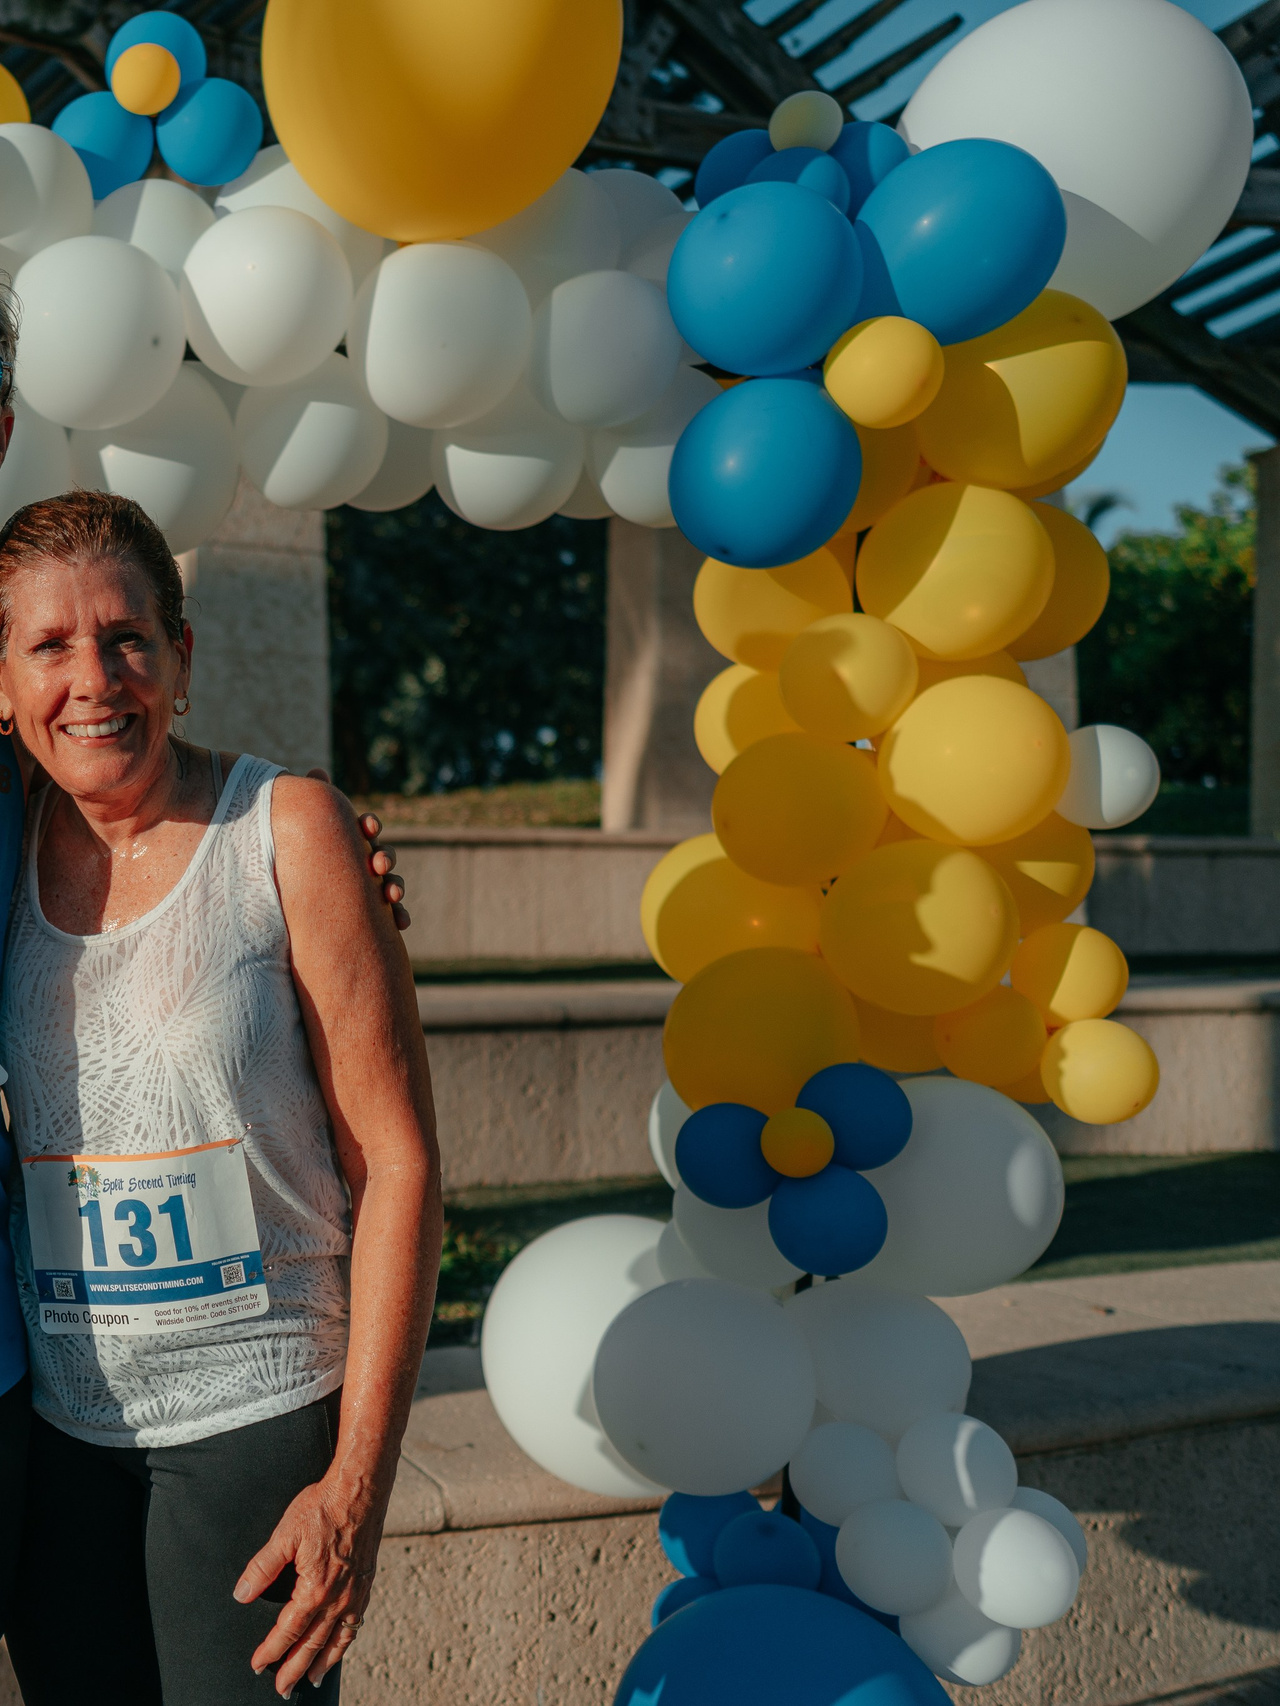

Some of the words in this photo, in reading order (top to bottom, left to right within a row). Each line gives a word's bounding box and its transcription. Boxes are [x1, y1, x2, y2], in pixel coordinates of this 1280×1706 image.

[102, 1178, 124, 1195] Split
[128, 1175, 164, 1192] Second
[166, 1172, 196, 1188] Timing
[78, 1194, 193, 1267] 131
[90, 1276, 204, 1292] WWW.SPLITSECONDTIMING.COM
[154, 1308, 171, 1317] Good
[173, 1307, 182, 1315] for
[184, 1305, 199, 1313] 10%
[200, 1302, 210, 1311] off
[211, 1299, 233, 1309] events
[234, 1294, 249, 1303] shot
[250, 1292, 258, 1301] by
[44, 1310, 79, 1323] Photo
[83, 1310, 129, 1327] Coupon
[155, 1316, 184, 1326] Wildside
[210, 1309, 227, 1318] Code
